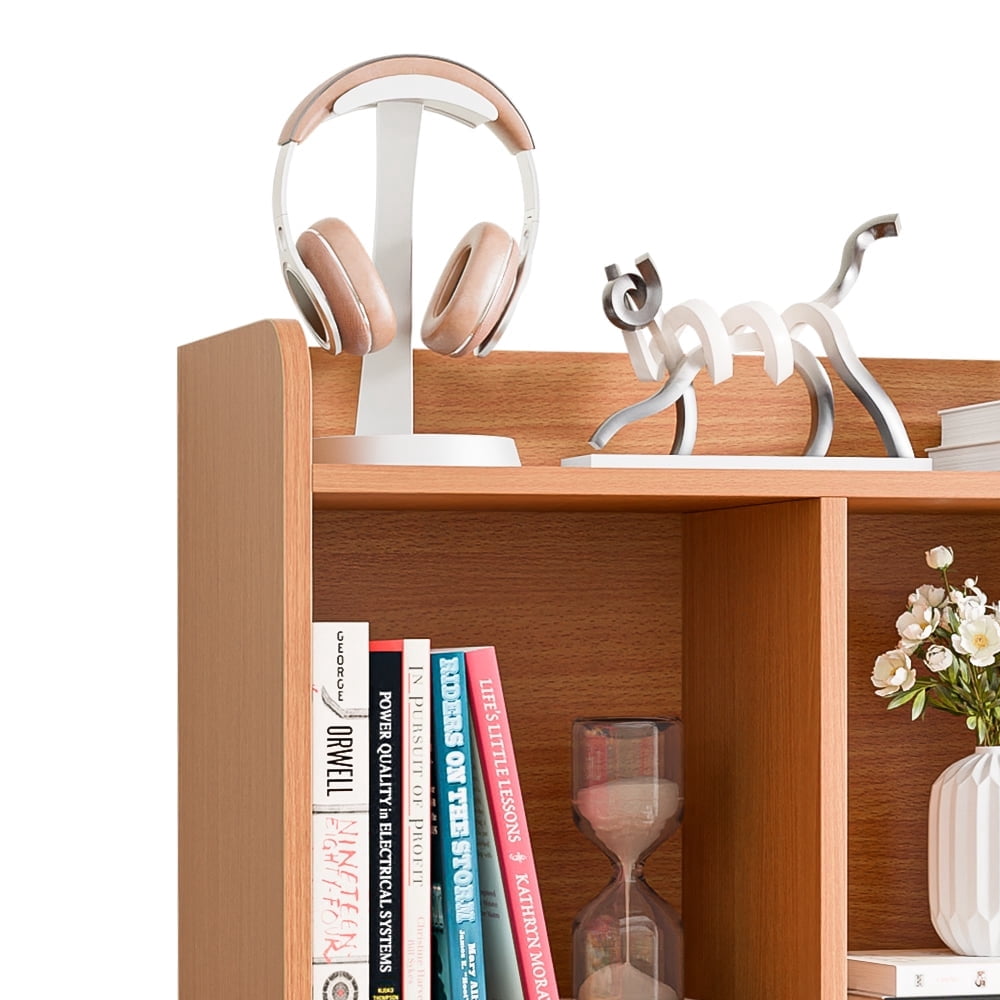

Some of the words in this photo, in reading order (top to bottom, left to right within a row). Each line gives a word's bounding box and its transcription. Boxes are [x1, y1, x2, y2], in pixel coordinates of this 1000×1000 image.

[336, 631, 345, 702] GEORGE
[378, 691, 392, 740] POWER
[439, 656, 464, 748] RIDERS
[479, 678, 499, 722] LIFE'S
[326, 725, 353, 797] ORWELL
[376, 743, 393, 806] QUALITY
[445, 750, 467, 784] ON
[487, 724, 509, 777] LITTLE
[378, 808, 392, 820] in
[448, 787, 471, 839] THE
[498, 779, 522, 843] LESSONS
[378, 822, 393, 908] ELECTRICAL
[451, 840, 476, 925] STORM
[378, 910, 393, 973] SYSTEMS
[515, 873, 541, 949] KATHRYN
